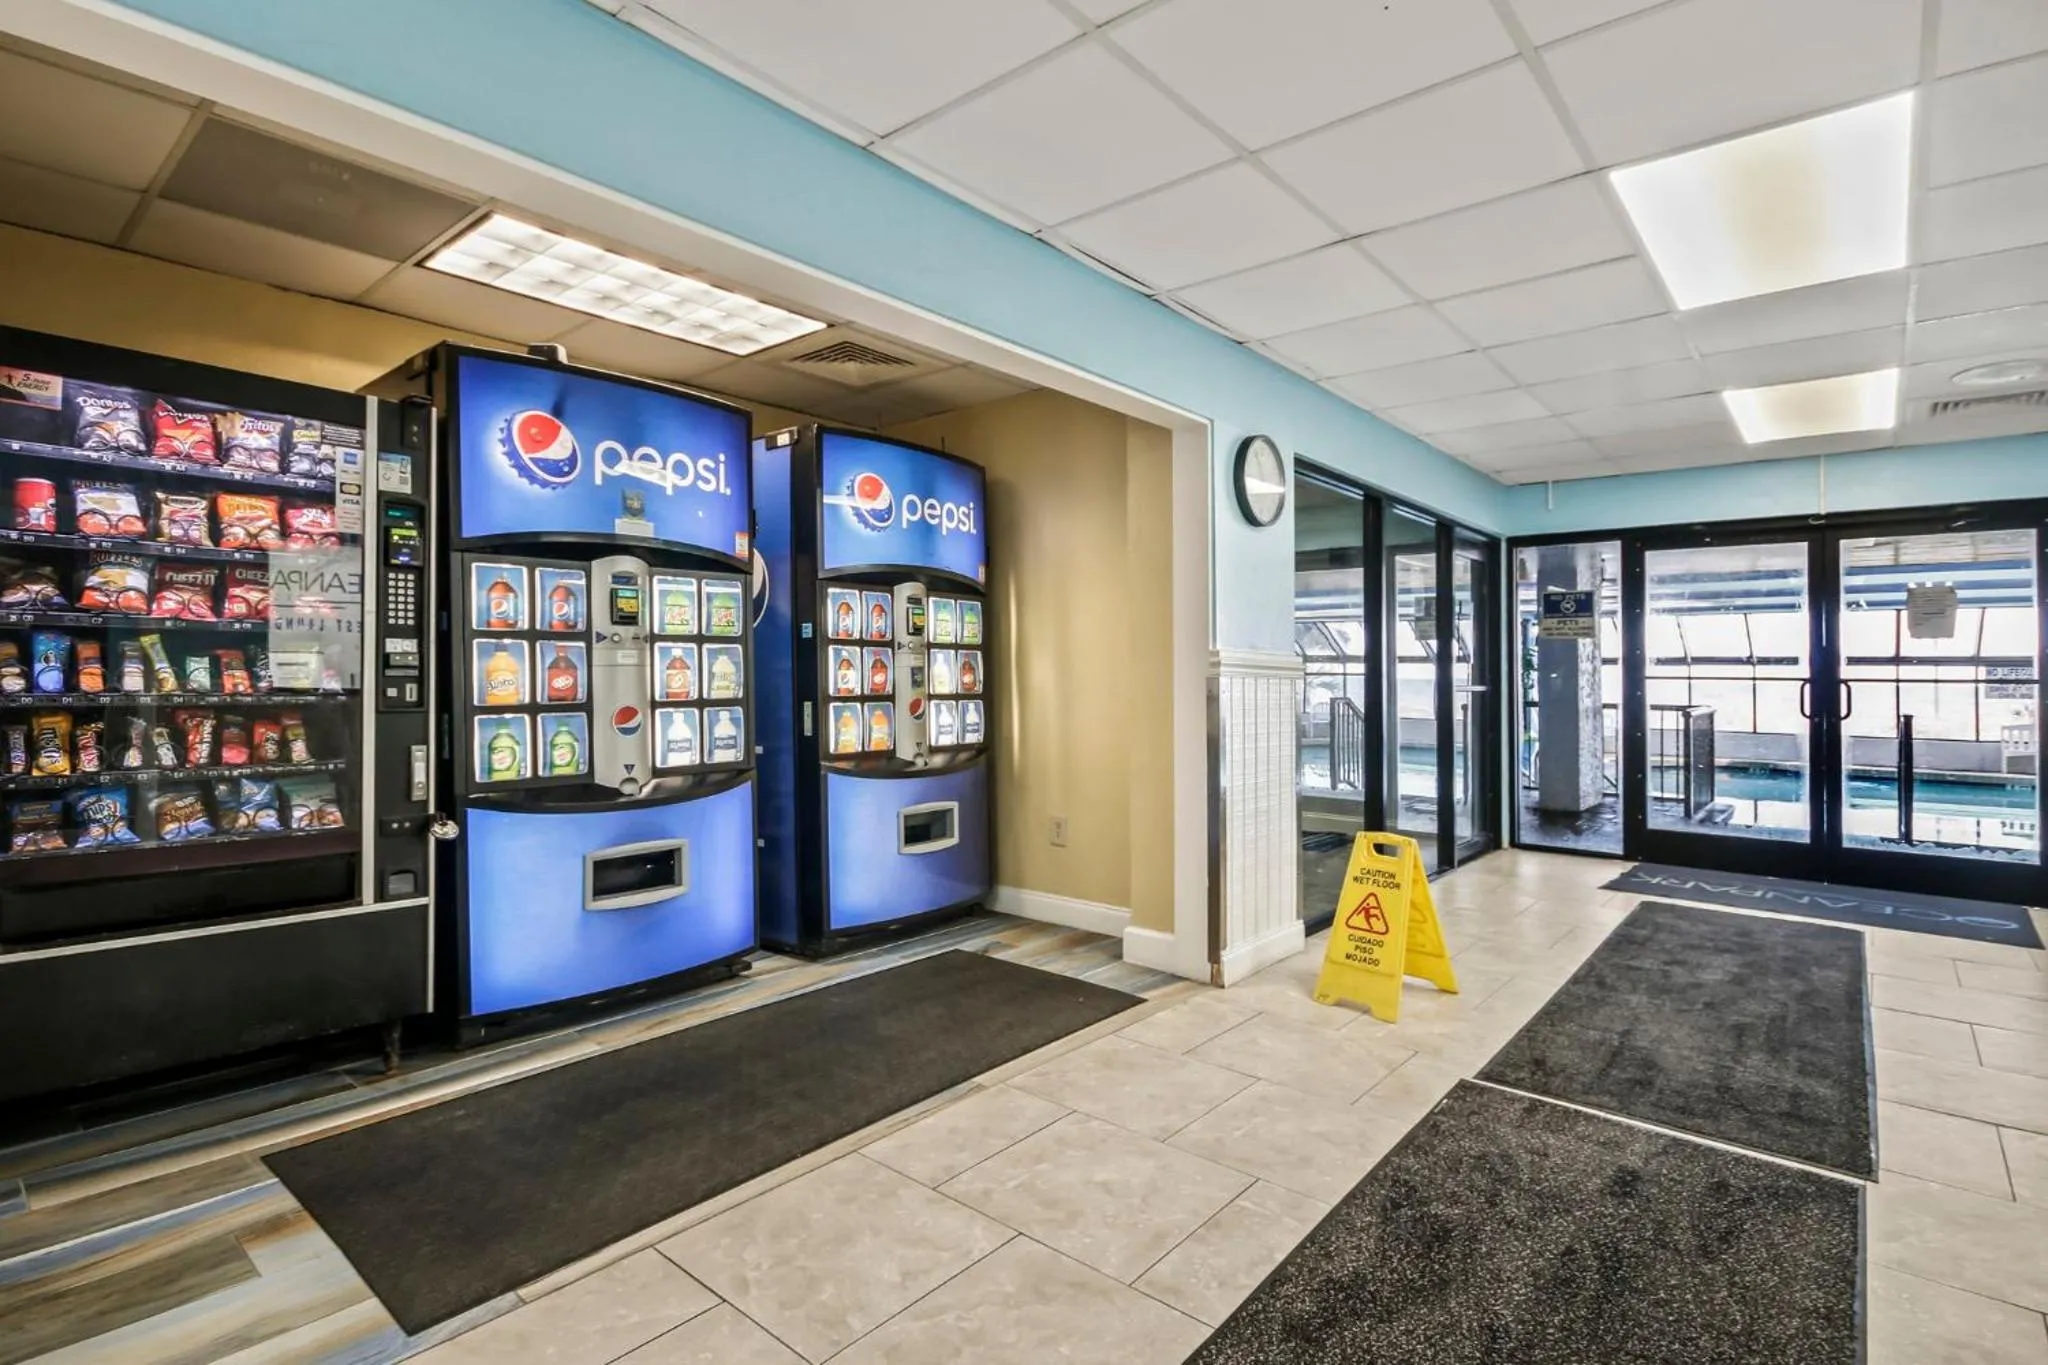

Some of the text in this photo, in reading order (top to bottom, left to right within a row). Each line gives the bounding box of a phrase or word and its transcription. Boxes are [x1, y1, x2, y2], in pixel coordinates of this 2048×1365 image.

[594, 440, 731, 495] pepsi
[902, 494, 977, 536] pepsi
[1359, 867, 1396, 880] CAUTION
[1352, 874, 1401, 891] WET FLOOR
[1632, 871, 2020, 930] OCEANPARK
[1347, 933, 1384, 949] CUIDADO
[1354, 944, 1374, 955] PISO
[1344, 952, 1380, 968] MOJADO
